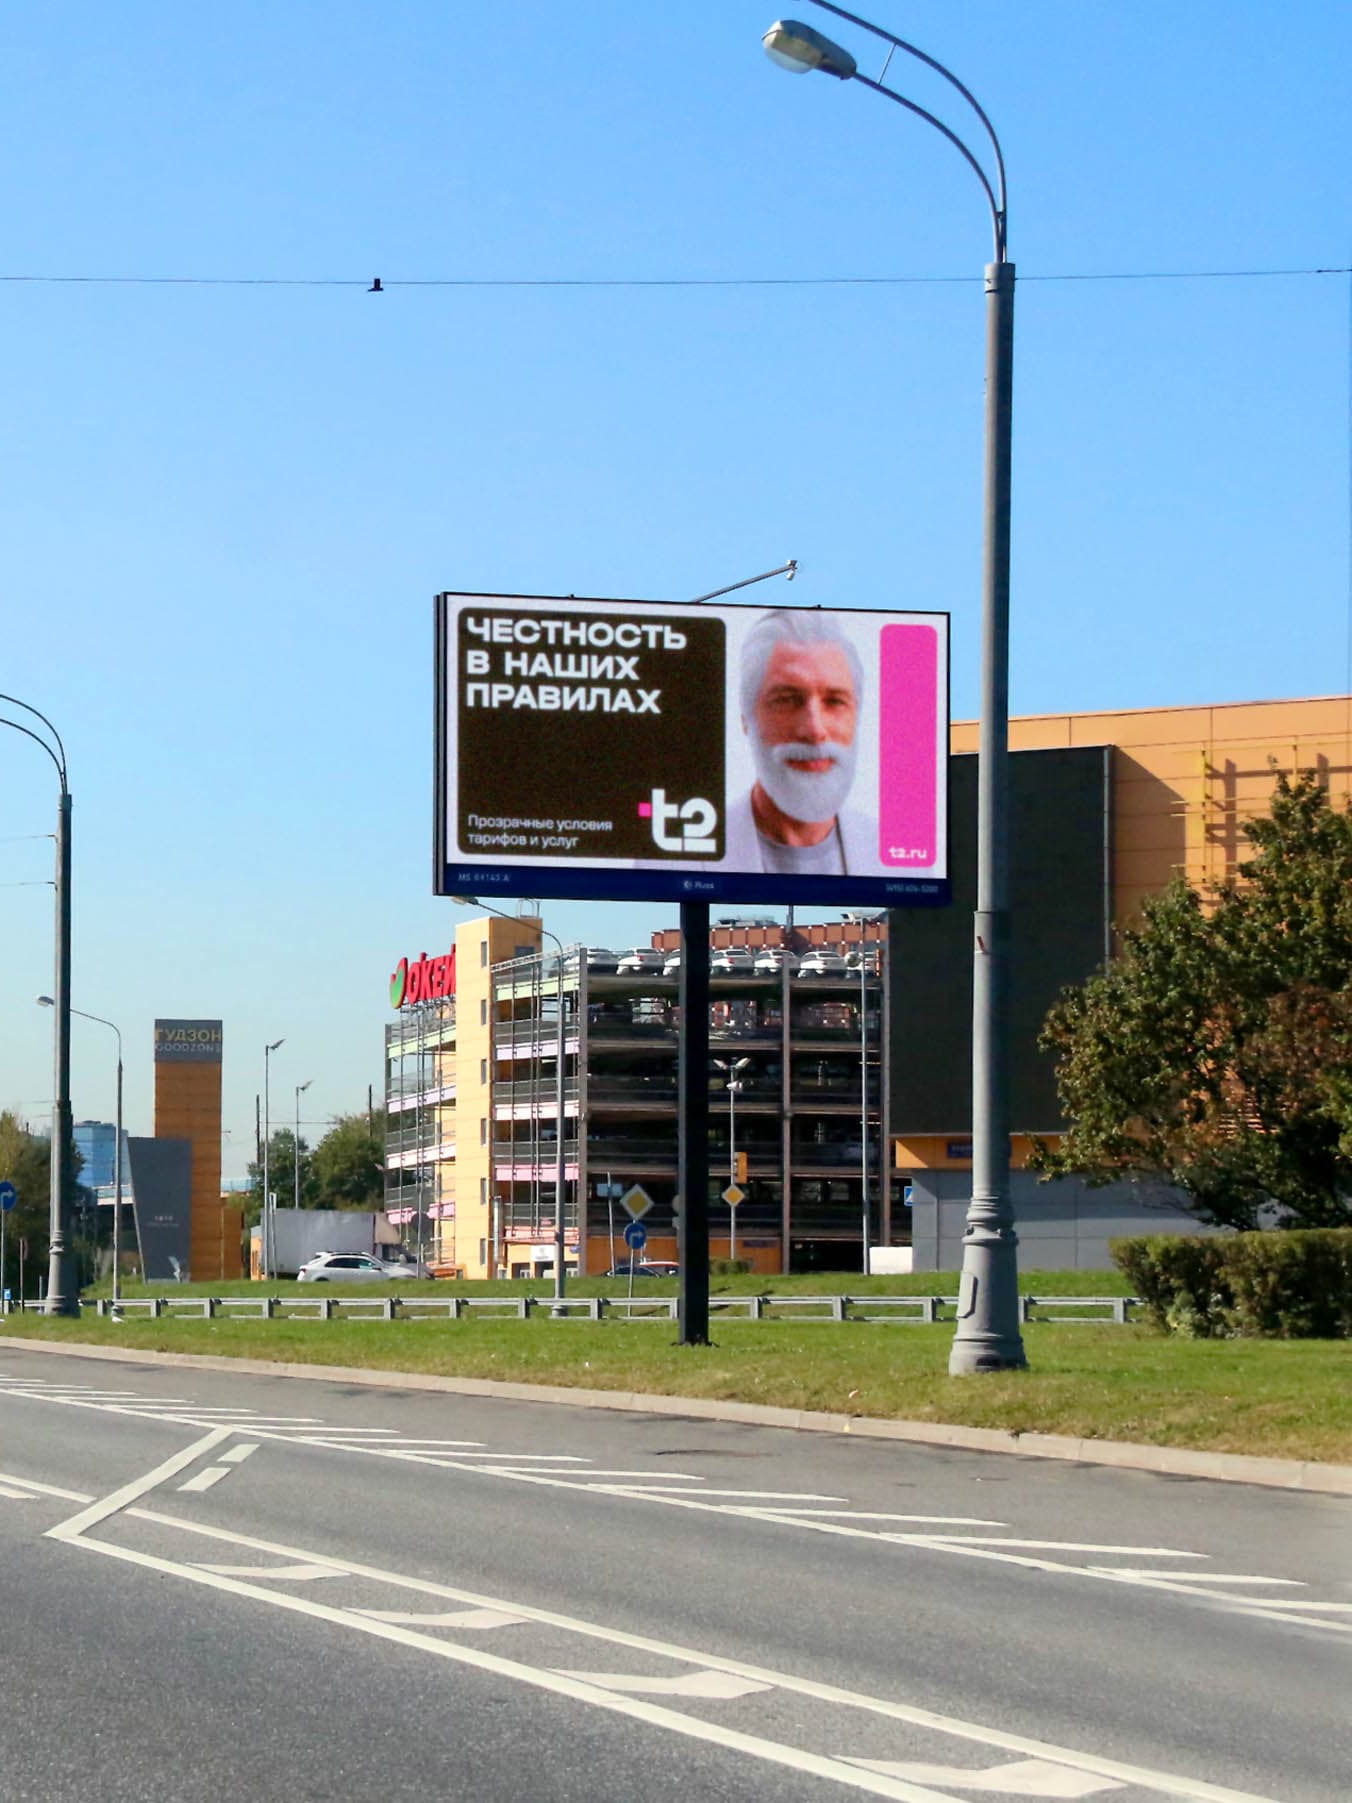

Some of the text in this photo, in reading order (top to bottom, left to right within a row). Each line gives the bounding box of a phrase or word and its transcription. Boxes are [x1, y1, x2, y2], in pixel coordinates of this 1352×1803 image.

[466, 617, 688, 650] ЧЕСТНОСТЬ
[466, 650, 640, 681] В НАШИХ
[466, 682, 662, 714] ПРАВИЛАХ
[468, 814, 613, 832] Прозрачные условия
[651, 788, 718, 852] t2
[468, 832, 579, 848] тарифов и услуг
[889, 846, 927, 859] t2.ru
[154, 1028, 221, 1042] ГУДЗОН
